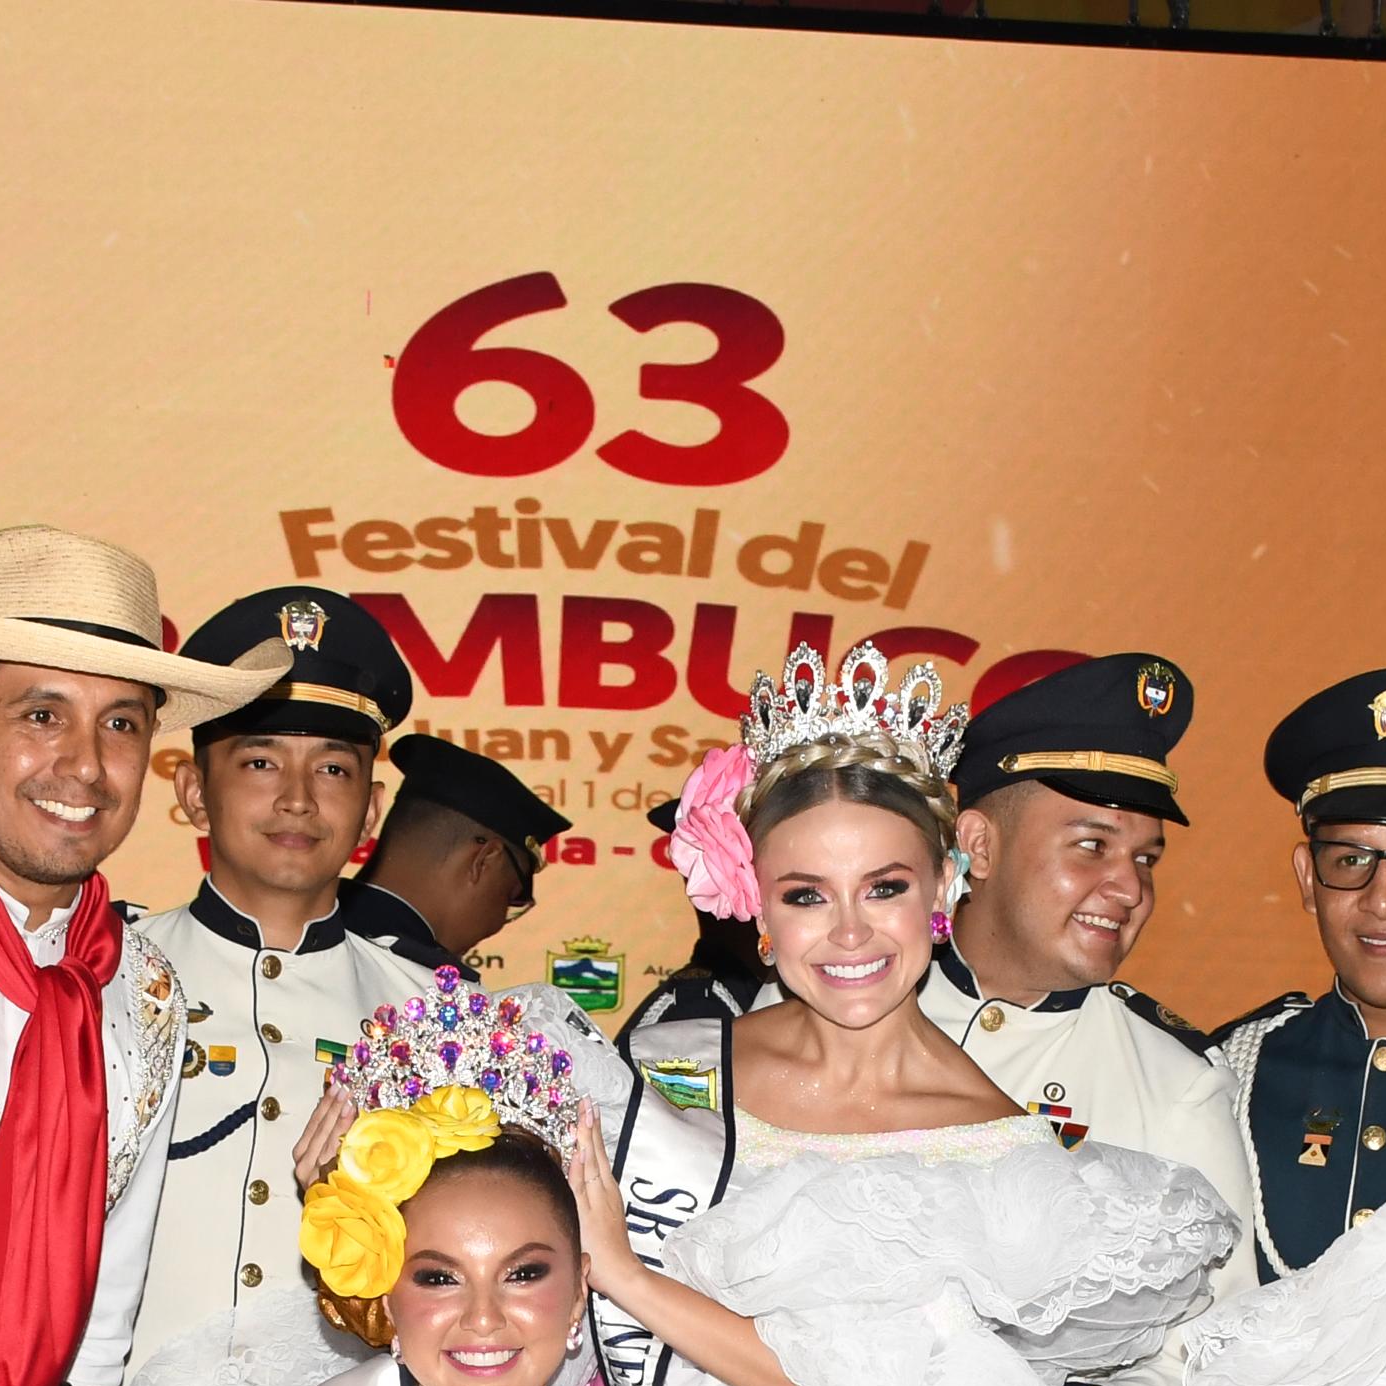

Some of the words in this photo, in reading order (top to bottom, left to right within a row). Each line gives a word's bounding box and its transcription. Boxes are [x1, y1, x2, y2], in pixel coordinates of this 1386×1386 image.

[392, 270, 790, 487] 63
[279, 498, 718, 580] Festival
[736, 521, 930, 610] del
[161, 592, 1098, 724] MBUC
[588, 731, 633, 772] y
[647, 724, 731, 768] Sa
